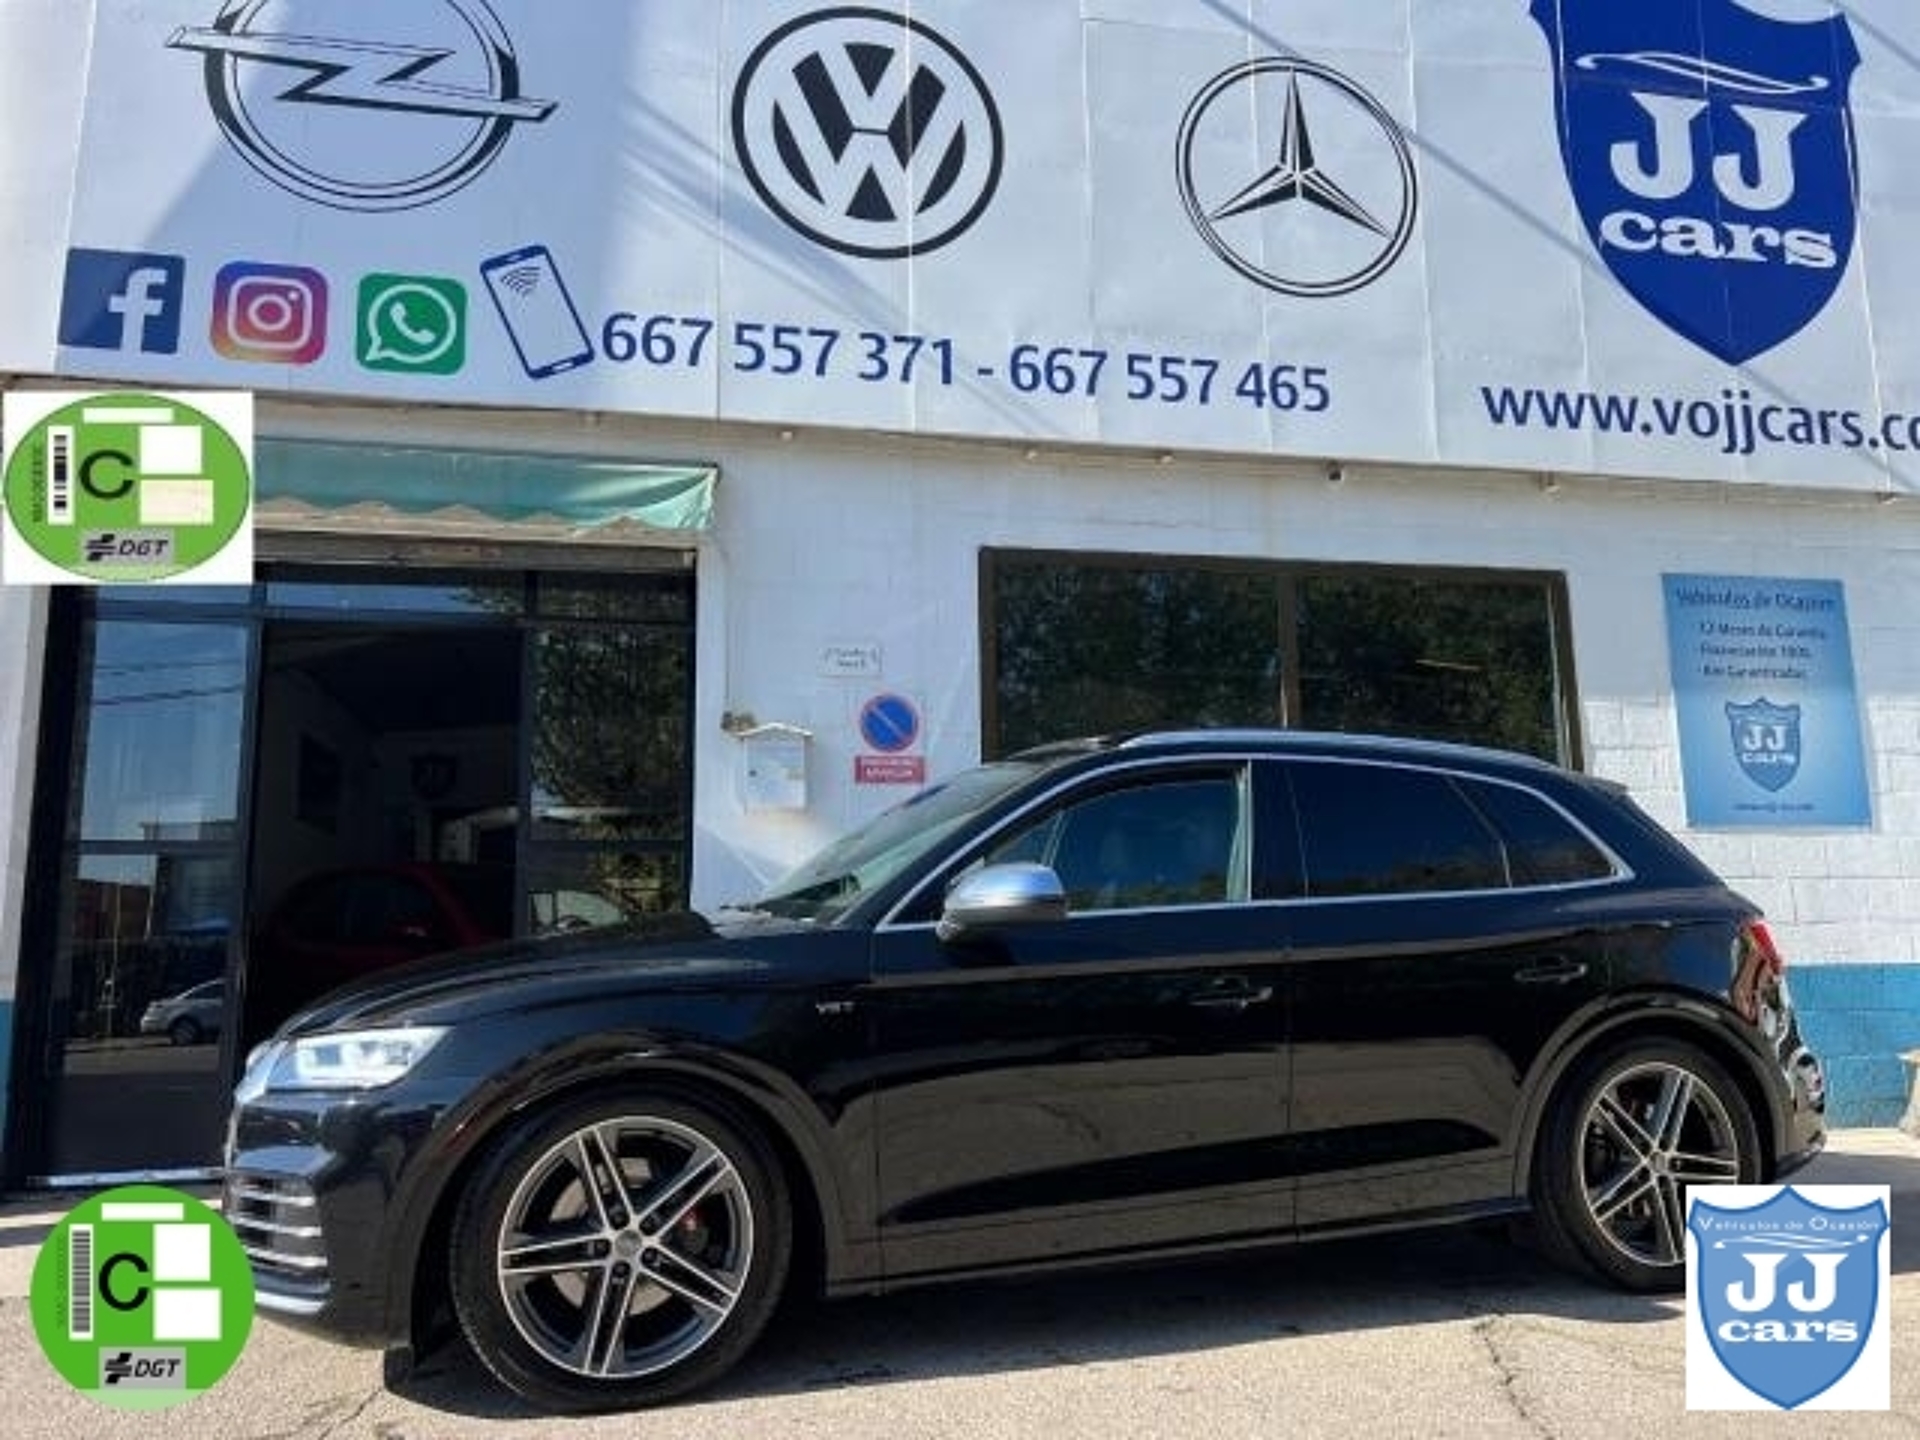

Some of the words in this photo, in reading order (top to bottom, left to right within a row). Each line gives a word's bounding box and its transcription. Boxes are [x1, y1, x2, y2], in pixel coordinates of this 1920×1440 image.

[1610, 91, 1808, 211] JJ
[1600, 210, 1838, 269] cars
[601, 311, 713, 367] 667
[734, 322, 840, 377] 557
[858, 332, 953, 385] 371
[1009, 344, 1108, 396] 667
[1126, 353, 1219, 405] 557
[1235, 362, 1330, 412] 465
[1742, 725, 1787, 750] JJ
